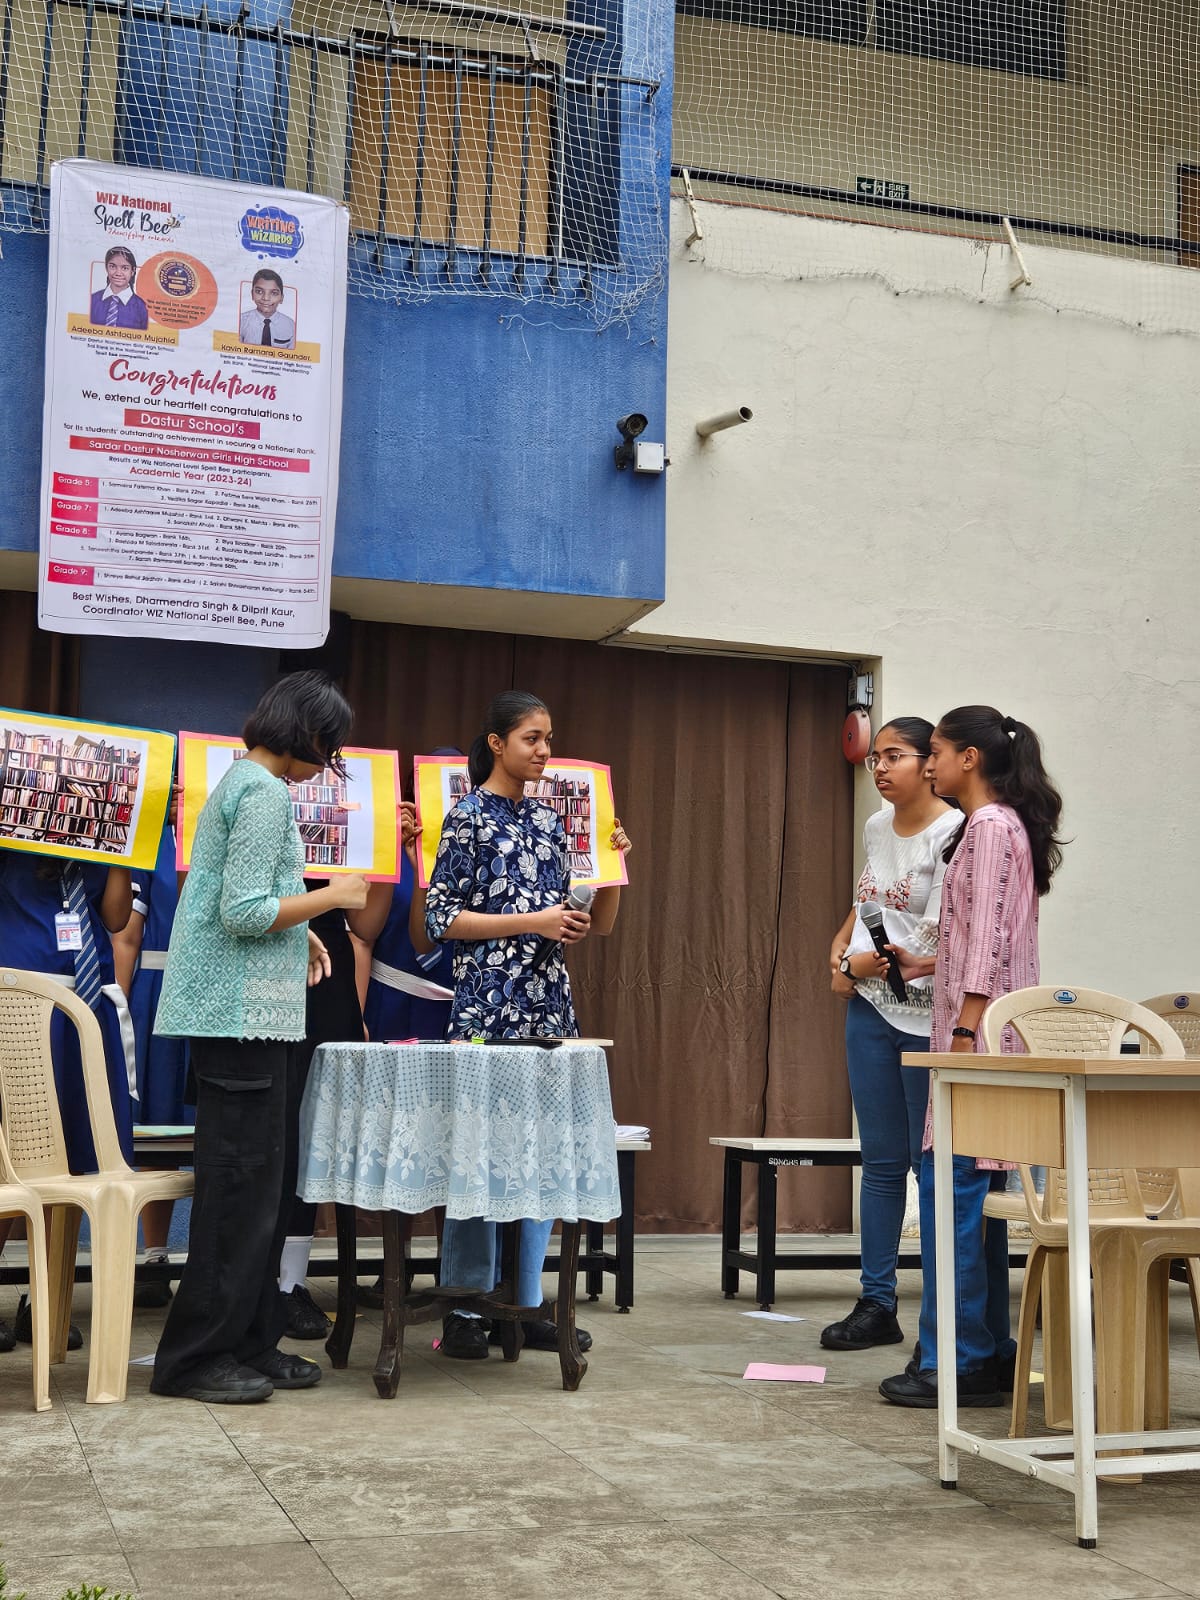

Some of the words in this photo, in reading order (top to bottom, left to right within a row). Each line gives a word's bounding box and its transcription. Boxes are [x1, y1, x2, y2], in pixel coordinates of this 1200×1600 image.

[888, 183, 906, 191] FIRE
[96, 191, 119, 206] WIZ
[121, 195, 172, 213] National
[94, 204, 134, 231] Spell
[140, 212, 170, 234] Bee
[72, 326, 102, 335] Adeeba
[144, 334, 176, 344] Mujahid
[222, 344, 242, 352] Kavin
[244, 348, 276, 358] Ramaraj
[109, 358, 278, 400] Congratulations
[82, 390, 100, 401] We,
[105, 393, 140, 404] extend
[144, 397, 161, 406] our
[164, 398, 207, 410] heartfelt
[210, 404, 290, 420] congratulations
[292, 414, 302, 422] to
[140, 413, 184, 428] Dastur
[188, 418, 245, 435] School's
[64, 422, 73, 430] for
[76, 424, 84, 432] its
[120, 429, 164, 440] outstanding
[166, 434, 215, 445] achievement
[226, 440, 256, 450] securing
[265, 444, 295, 454] National
[89, 440, 121, 450] Sardar
[124, 444, 154, 454] Dastur
[156, 448, 209, 459] Nosherwan
[212, 451, 232, 462] Girls
[234, 455, 254, 466] High
[258, 458, 289, 468] School
[108, 456, 130, 464] Results
[141, 458, 152, 466] Wiz
[154, 460, 182, 468] National
[232, 468, 272, 478] participants.
[130, 466, 180, 478] Academic
[184, 471, 204, 481] Year
[207, 473, 252, 487] (2023-24)
[58, 476, 82, 486] Grade
[56, 500, 82, 511] Grade
[84, 504, 92, 512] 7:
[56, 524, 80, 534] Grade
[53, 566, 78, 575] Grade
[72, 592, 92, 601] Best
[96, 593, 132, 604] Wishes,
[136, 596, 200, 608] Dharmendra
[202, 600, 228, 612] Singh
[232, 604, 238, 612] &
[242, 604, 268, 615] Dilprit
[272, 607, 295, 618] Kaur,
[82, 605, 144, 616] Coordinator
[146, 608, 164, 618] WIZ
[166, 610, 208, 621] National
[212, 614, 234, 624] Spell
[238, 616, 258, 627] Bee,
[260, 618, 284, 628] Pune
